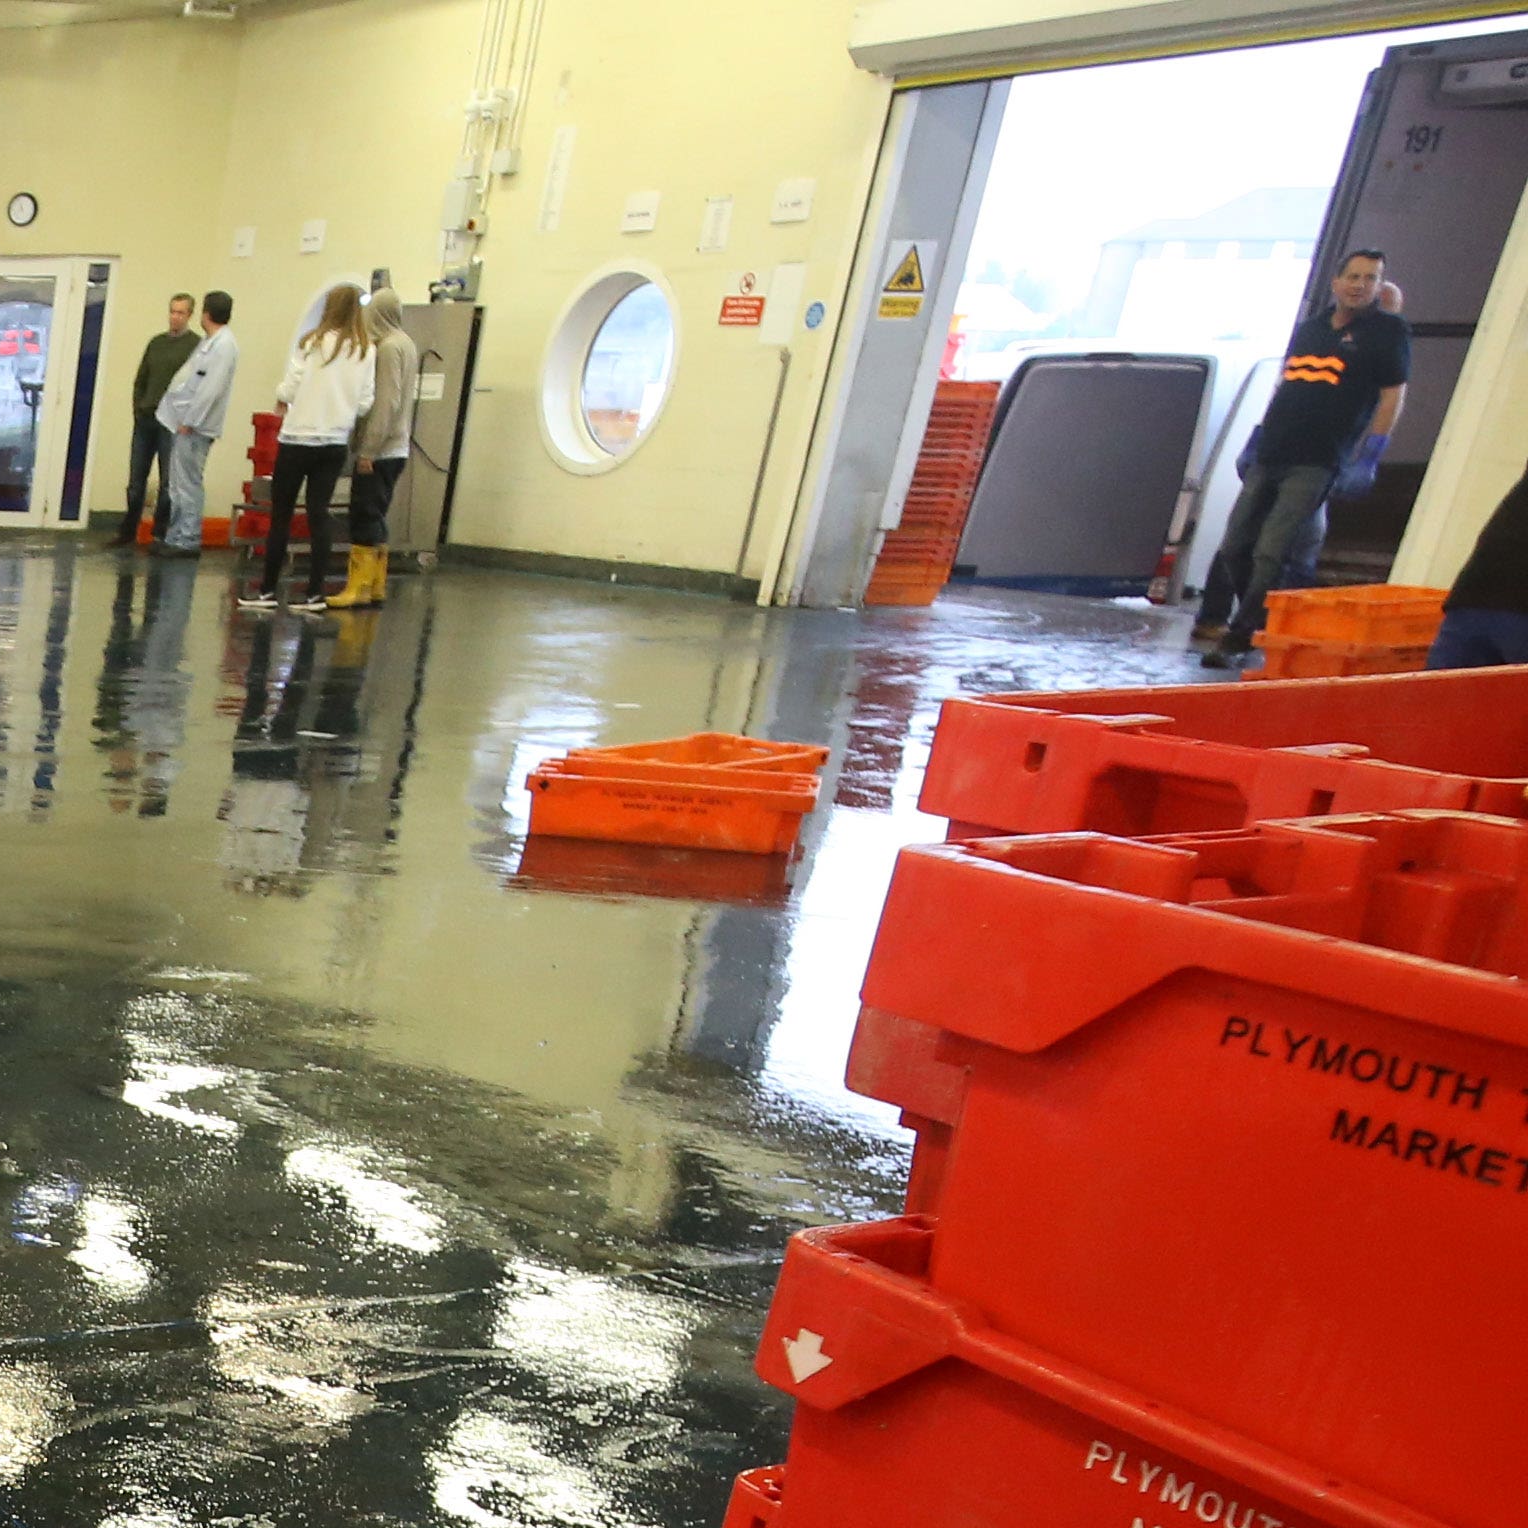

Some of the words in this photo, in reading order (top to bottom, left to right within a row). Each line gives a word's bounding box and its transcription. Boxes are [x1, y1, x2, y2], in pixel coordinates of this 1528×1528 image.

[1405, 124, 1445, 154] 191
[1220, 1016, 1488, 1112] PLYMOUTH
[1331, 1108, 1528, 1192] MARKET
